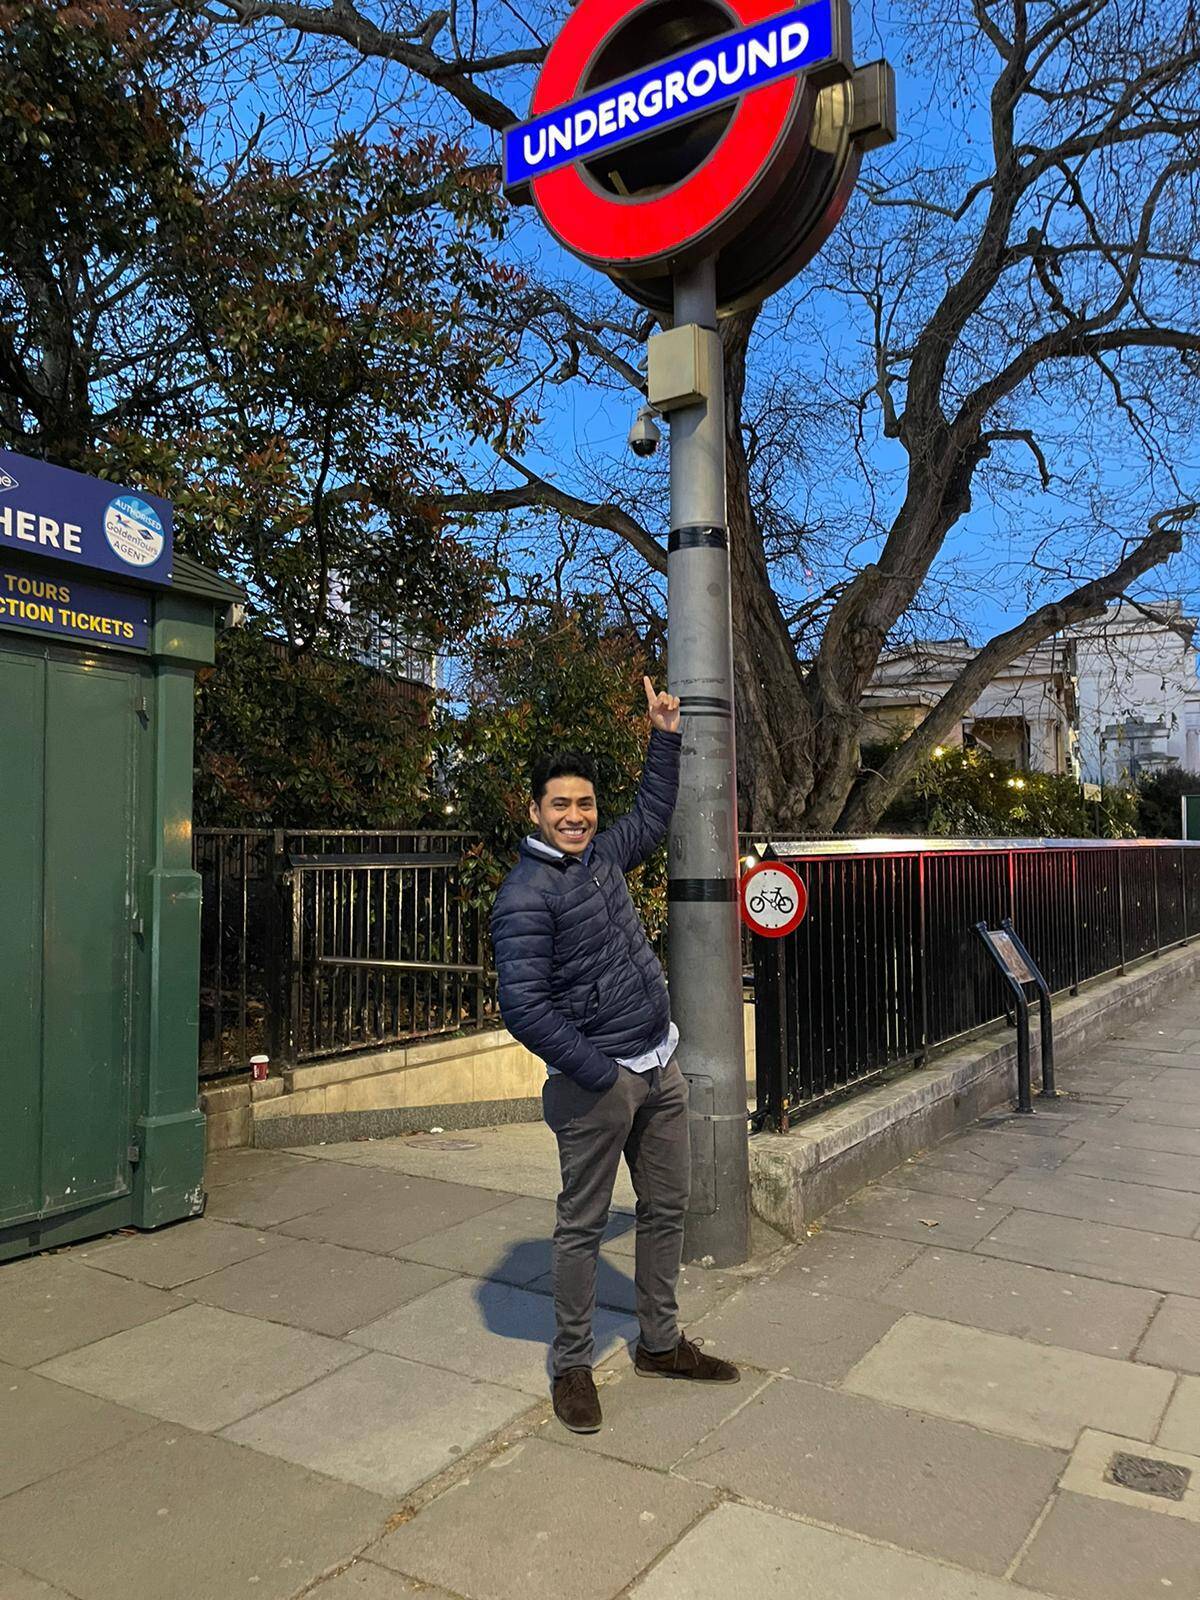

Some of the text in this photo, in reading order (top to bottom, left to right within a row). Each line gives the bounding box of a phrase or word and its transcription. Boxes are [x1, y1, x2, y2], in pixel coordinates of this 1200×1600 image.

[523, 22, 810, 165] UNDERGROUND
[114, 499, 162, 530] AUTHORISED
[113, 540, 147, 563] AGENT
[4, 574, 71, 604] TOURS
[58, 608, 134, 639] TICKETS
